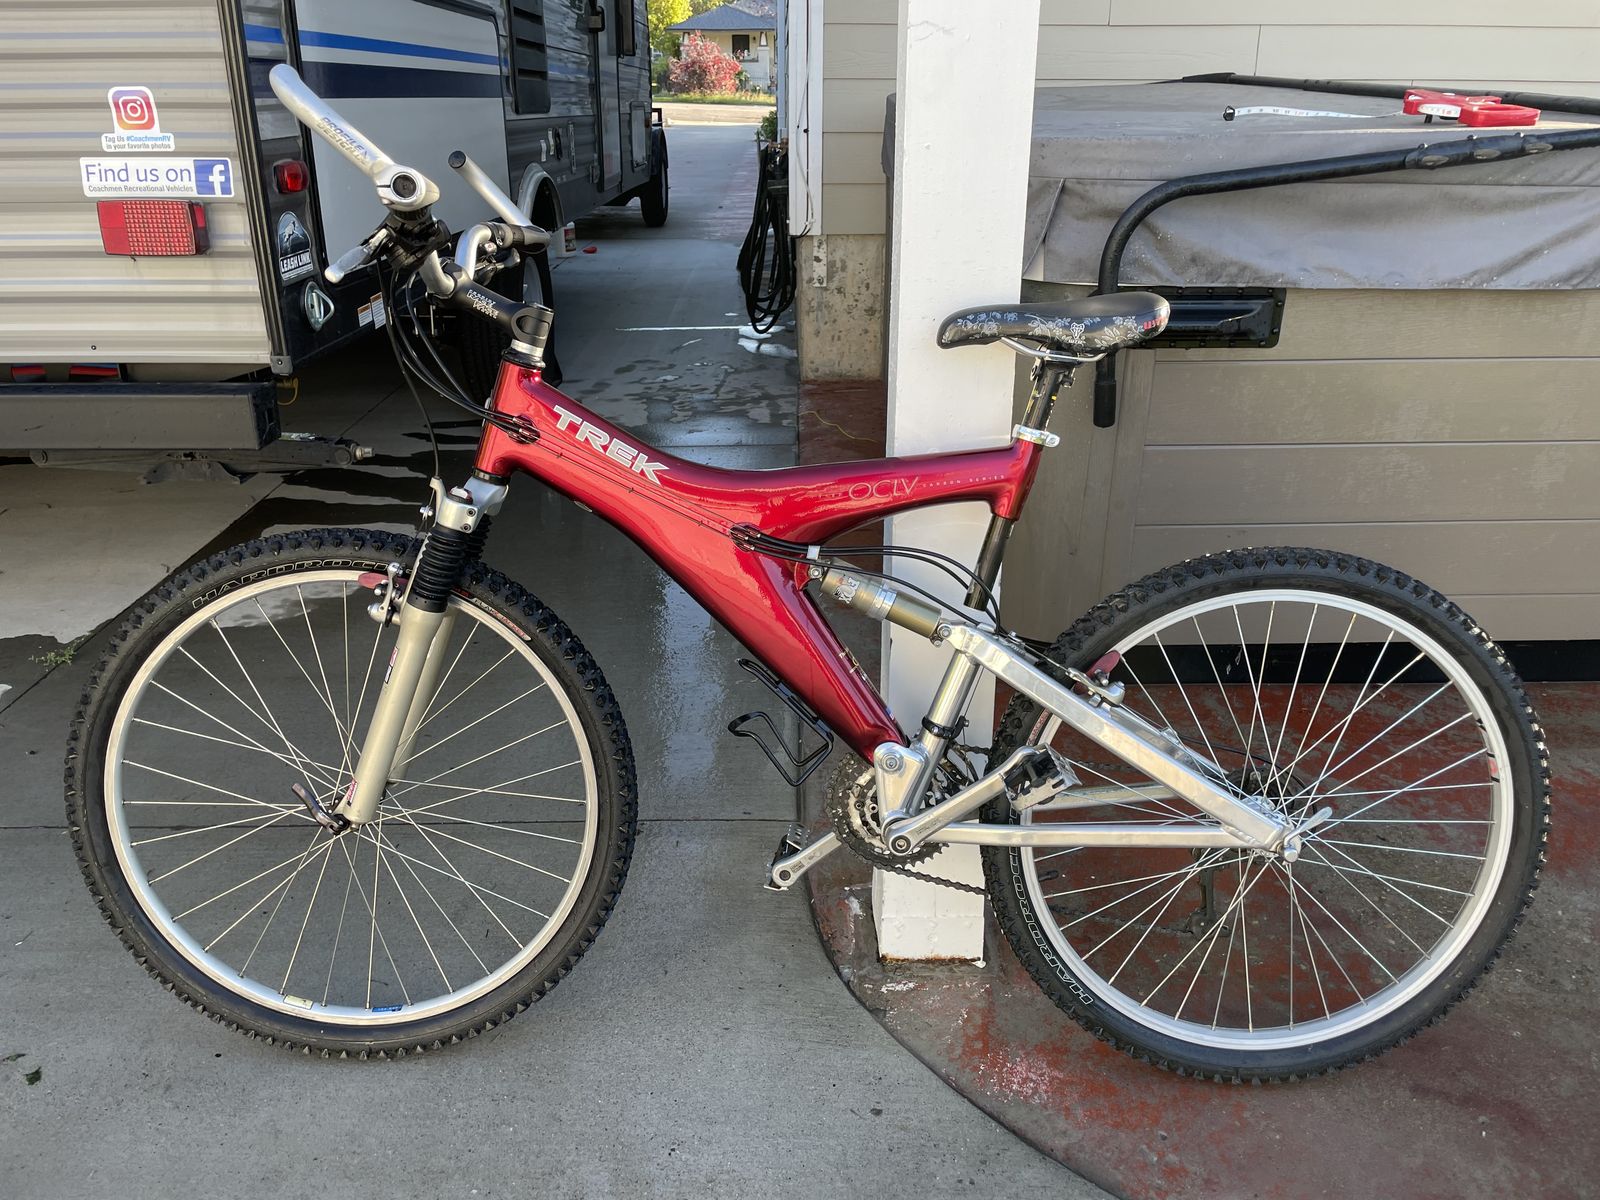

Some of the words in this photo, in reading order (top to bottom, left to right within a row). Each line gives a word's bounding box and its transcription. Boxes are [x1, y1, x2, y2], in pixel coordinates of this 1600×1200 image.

[85, 162, 129, 182] Find
[136, 168, 159, 182] us
[165, 168, 191, 182] on
[553, 404, 670, 486] TREK
[849, 476, 919, 500] OCLV
